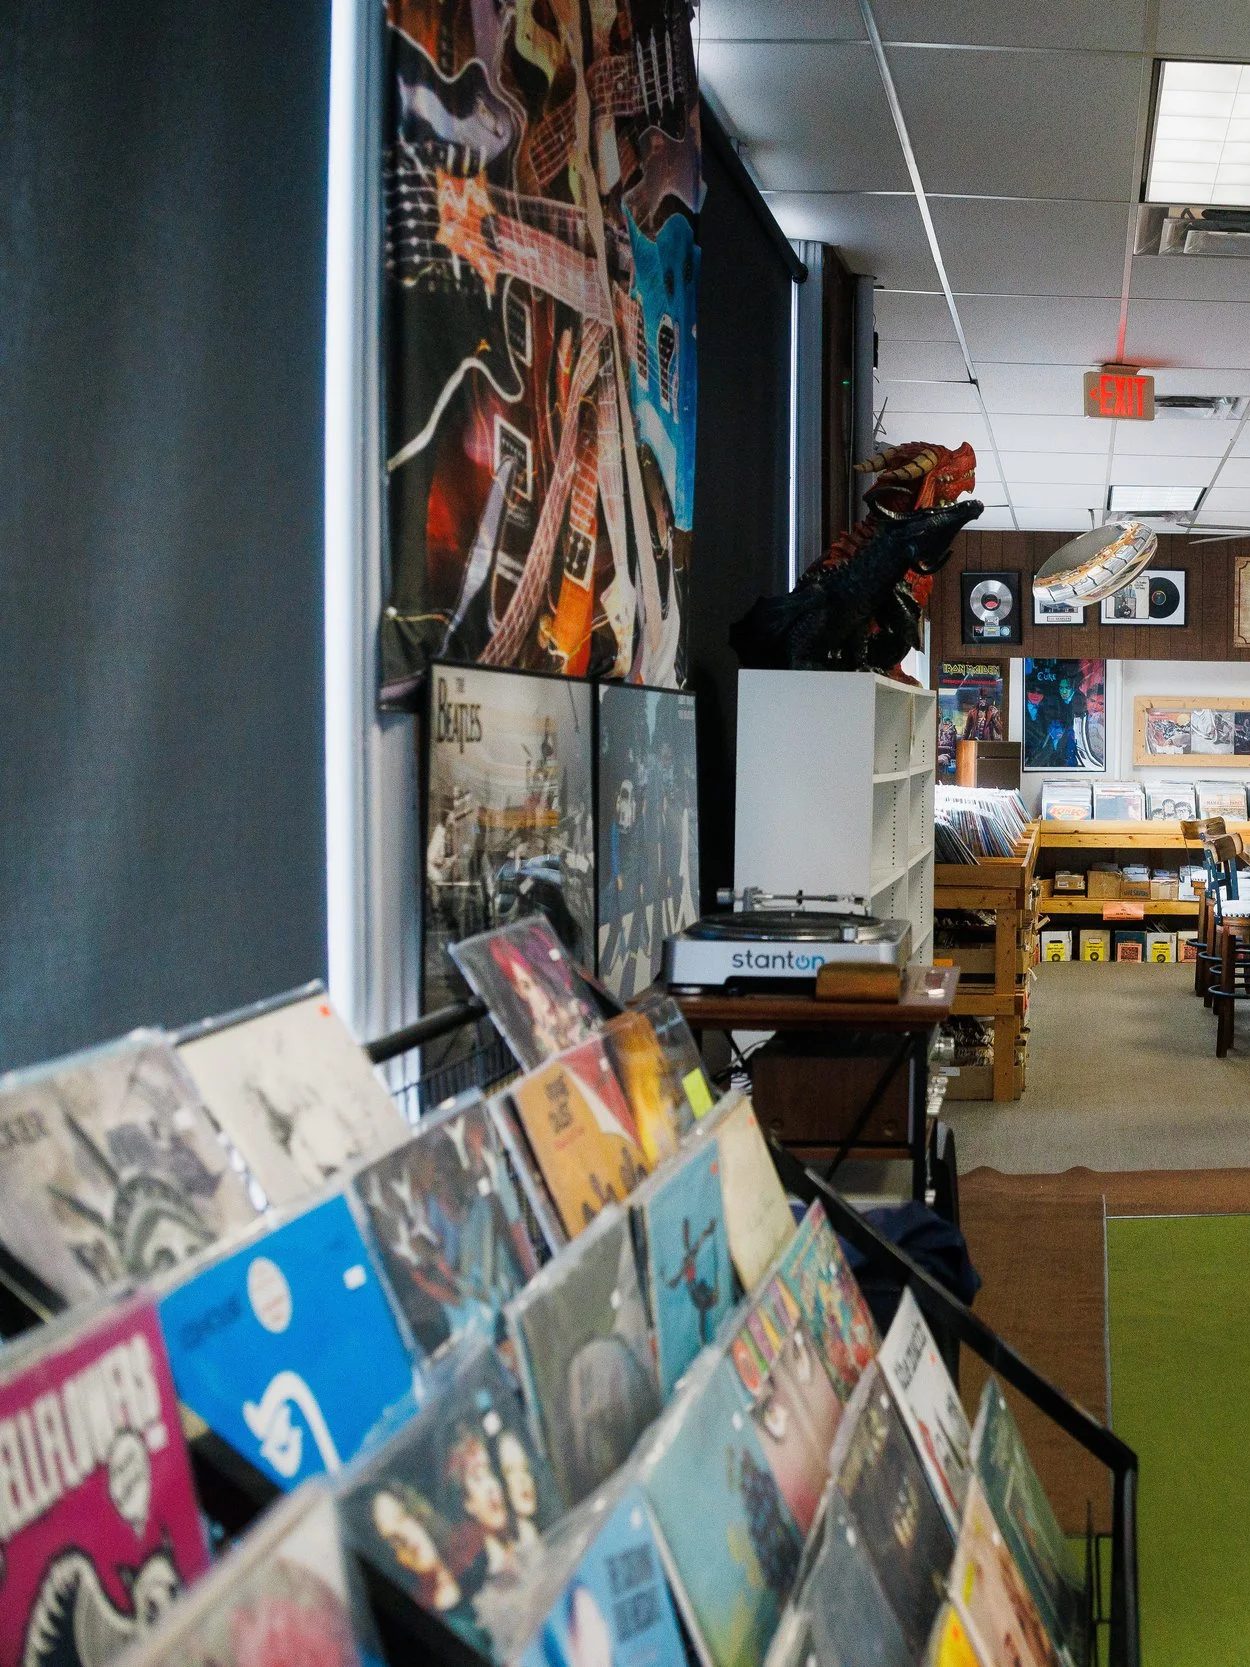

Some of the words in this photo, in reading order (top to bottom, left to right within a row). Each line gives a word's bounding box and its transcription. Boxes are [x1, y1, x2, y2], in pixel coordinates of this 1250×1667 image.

[1099, 374, 1147, 417] EXIT
[436, 676, 482, 754] BEATLES
[732, 950, 825, 970] stanton
